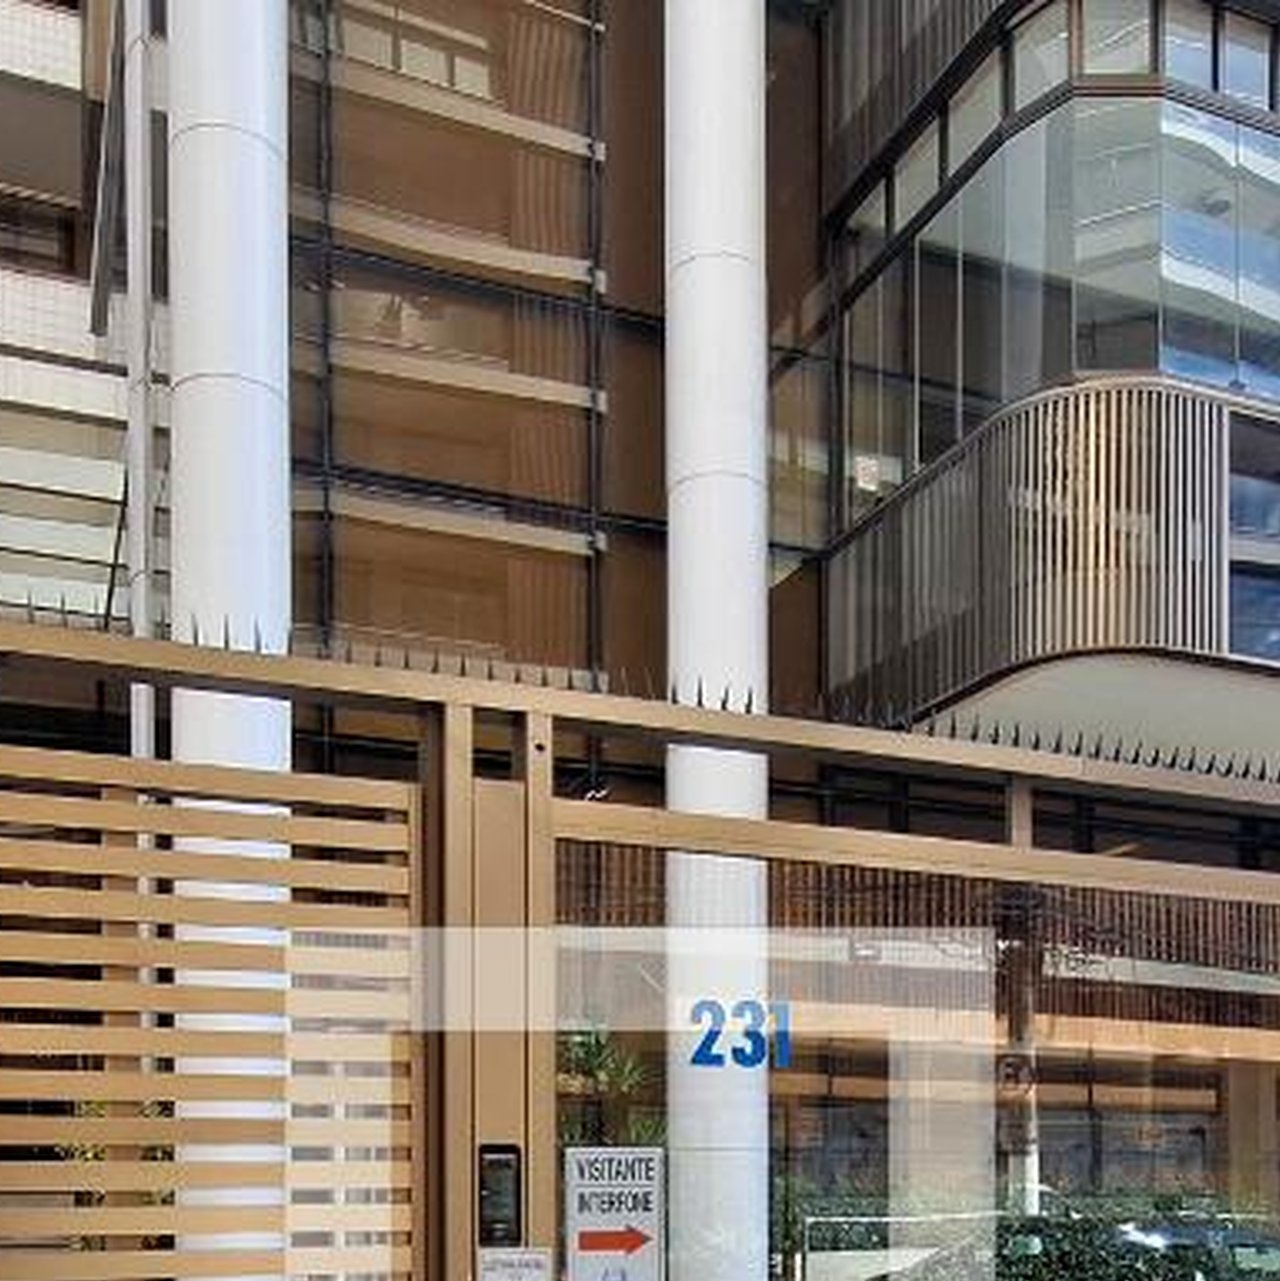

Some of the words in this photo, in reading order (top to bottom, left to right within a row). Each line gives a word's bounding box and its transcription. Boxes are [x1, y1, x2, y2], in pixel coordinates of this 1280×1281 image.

[691, 1000, 790, 1067] 231
[576, 1157, 655, 1181] VISITANTE
[577, 1191, 654, 1214] INTERFONE
